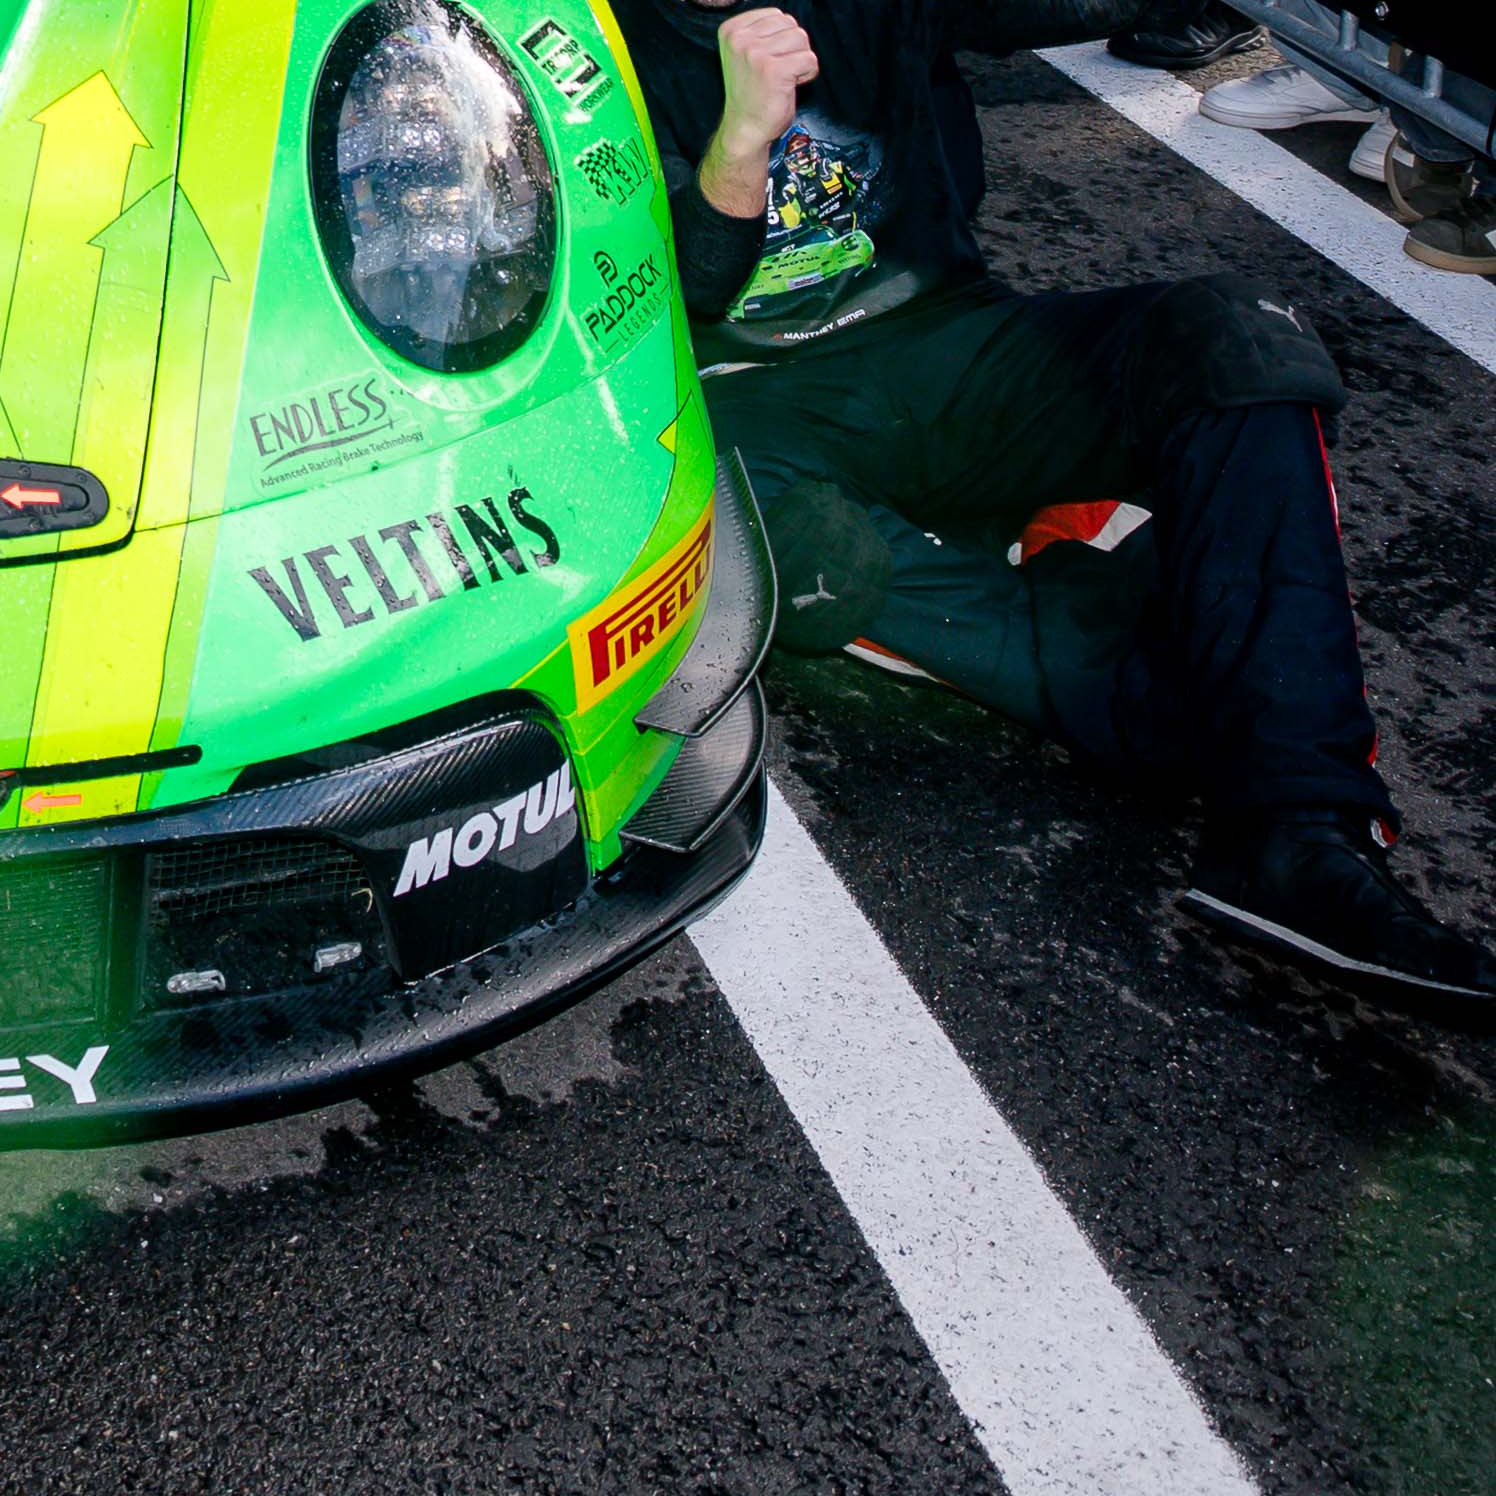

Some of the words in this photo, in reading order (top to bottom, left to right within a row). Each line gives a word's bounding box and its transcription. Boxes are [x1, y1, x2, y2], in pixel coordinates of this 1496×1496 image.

[584, 253, 662, 342] PADDOCK
[616, 293, 661, 343] LEGENDS
[783, 322, 834, 341] MANTHEY
[249, 377, 387, 457] ENDLESS
[260, 464, 310, 489] Advanced
[342, 446, 370, 463] Brake
[368, 430, 425, 455] Technology
[246, 484, 563, 644] VELTINS
[587, 519, 713, 687] PIRELLI
[392, 760, 576, 899] MOTUL
